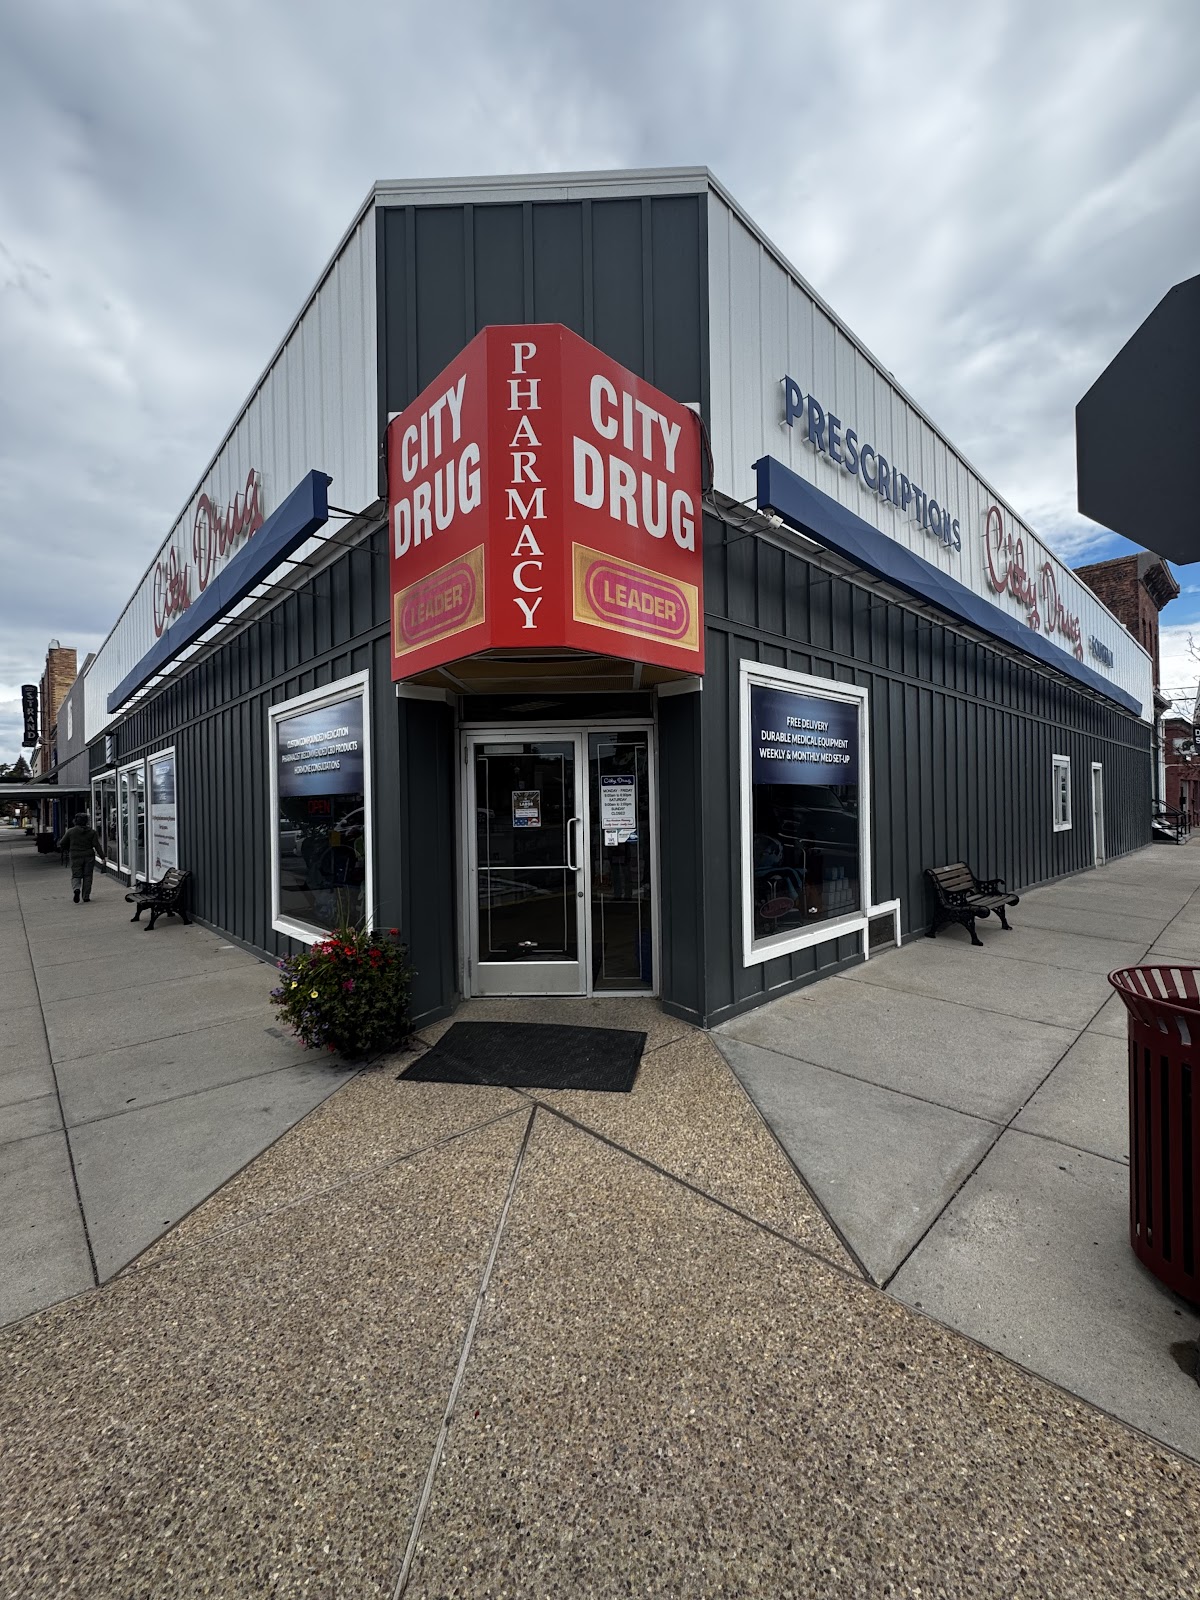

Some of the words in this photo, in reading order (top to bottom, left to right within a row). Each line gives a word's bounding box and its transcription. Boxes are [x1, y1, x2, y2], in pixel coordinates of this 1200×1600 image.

[402, 373, 467, 483] CITY
[590, 374, 682, 474] CITY
[785, 374, 962, 553] PRESCRIPTIONS
[394, 442, 481, 560] DRUG
[505, 342, 547, 629] PHARMACY
[573, 435, 695, 553] DRUG
[410, 584, 464, 627] LEADER
[604, 579, 677, 622] LEADER
[986, 505, 1041, 632] City
[1043, 561, 1084, 663] Drug
[26, 692, 36, 739] STRAND
[324, 726, 349, 741] MEDICATION
[786, 716, 801, 728] FREE
[802, 719, 829, 731] DELIVERY
[335, 740, 358, 753] PRODUCTS
[759, 747, 786, 760] WEEKLY
[786, 750, 791, 760] &
[792, 751, 821, 762] MONTHLY
[821, 752, 833, 763] MED
[833, 754, 850, 764] SET-UP
[761, 730, 791, 743] DURABLE
[792, 734, 818, 746] MEDICAL
[818, 737, 849, 749] EQUIPMENT
[311, 759, 340, 772] CONSULTATIONS
[308, 800, 330, 814] OPEN
